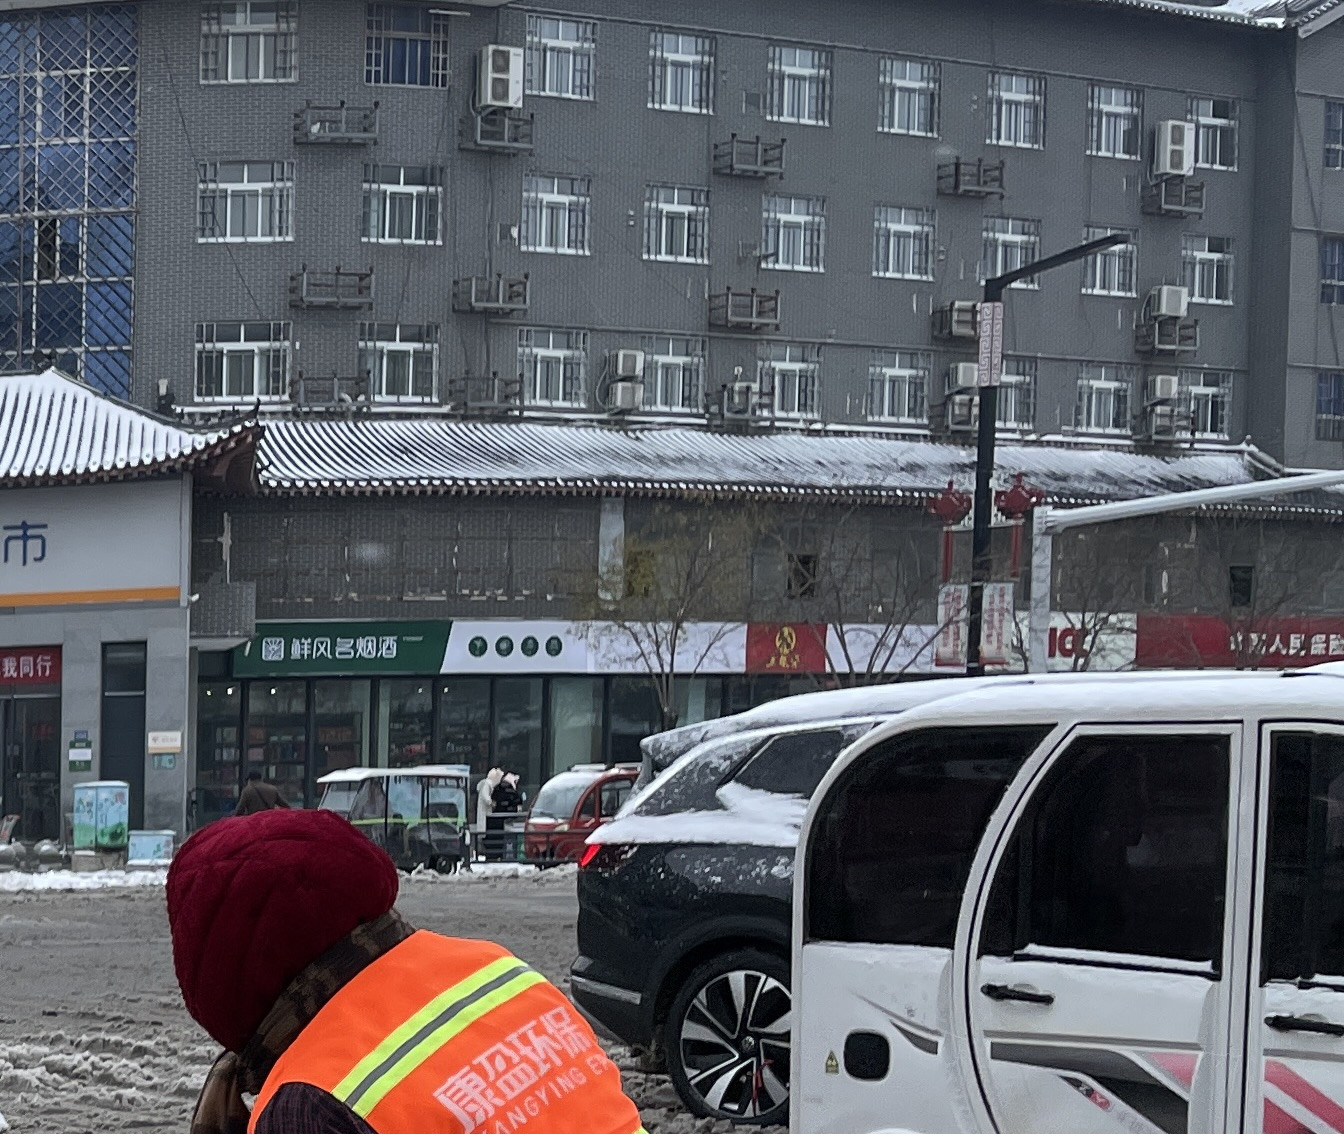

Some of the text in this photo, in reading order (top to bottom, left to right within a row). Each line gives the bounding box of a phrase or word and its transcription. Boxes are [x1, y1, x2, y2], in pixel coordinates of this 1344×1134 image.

[290, 635, 398, 660] 鲜风名烟酒
[1048, 627, 1089, 658] ICC
